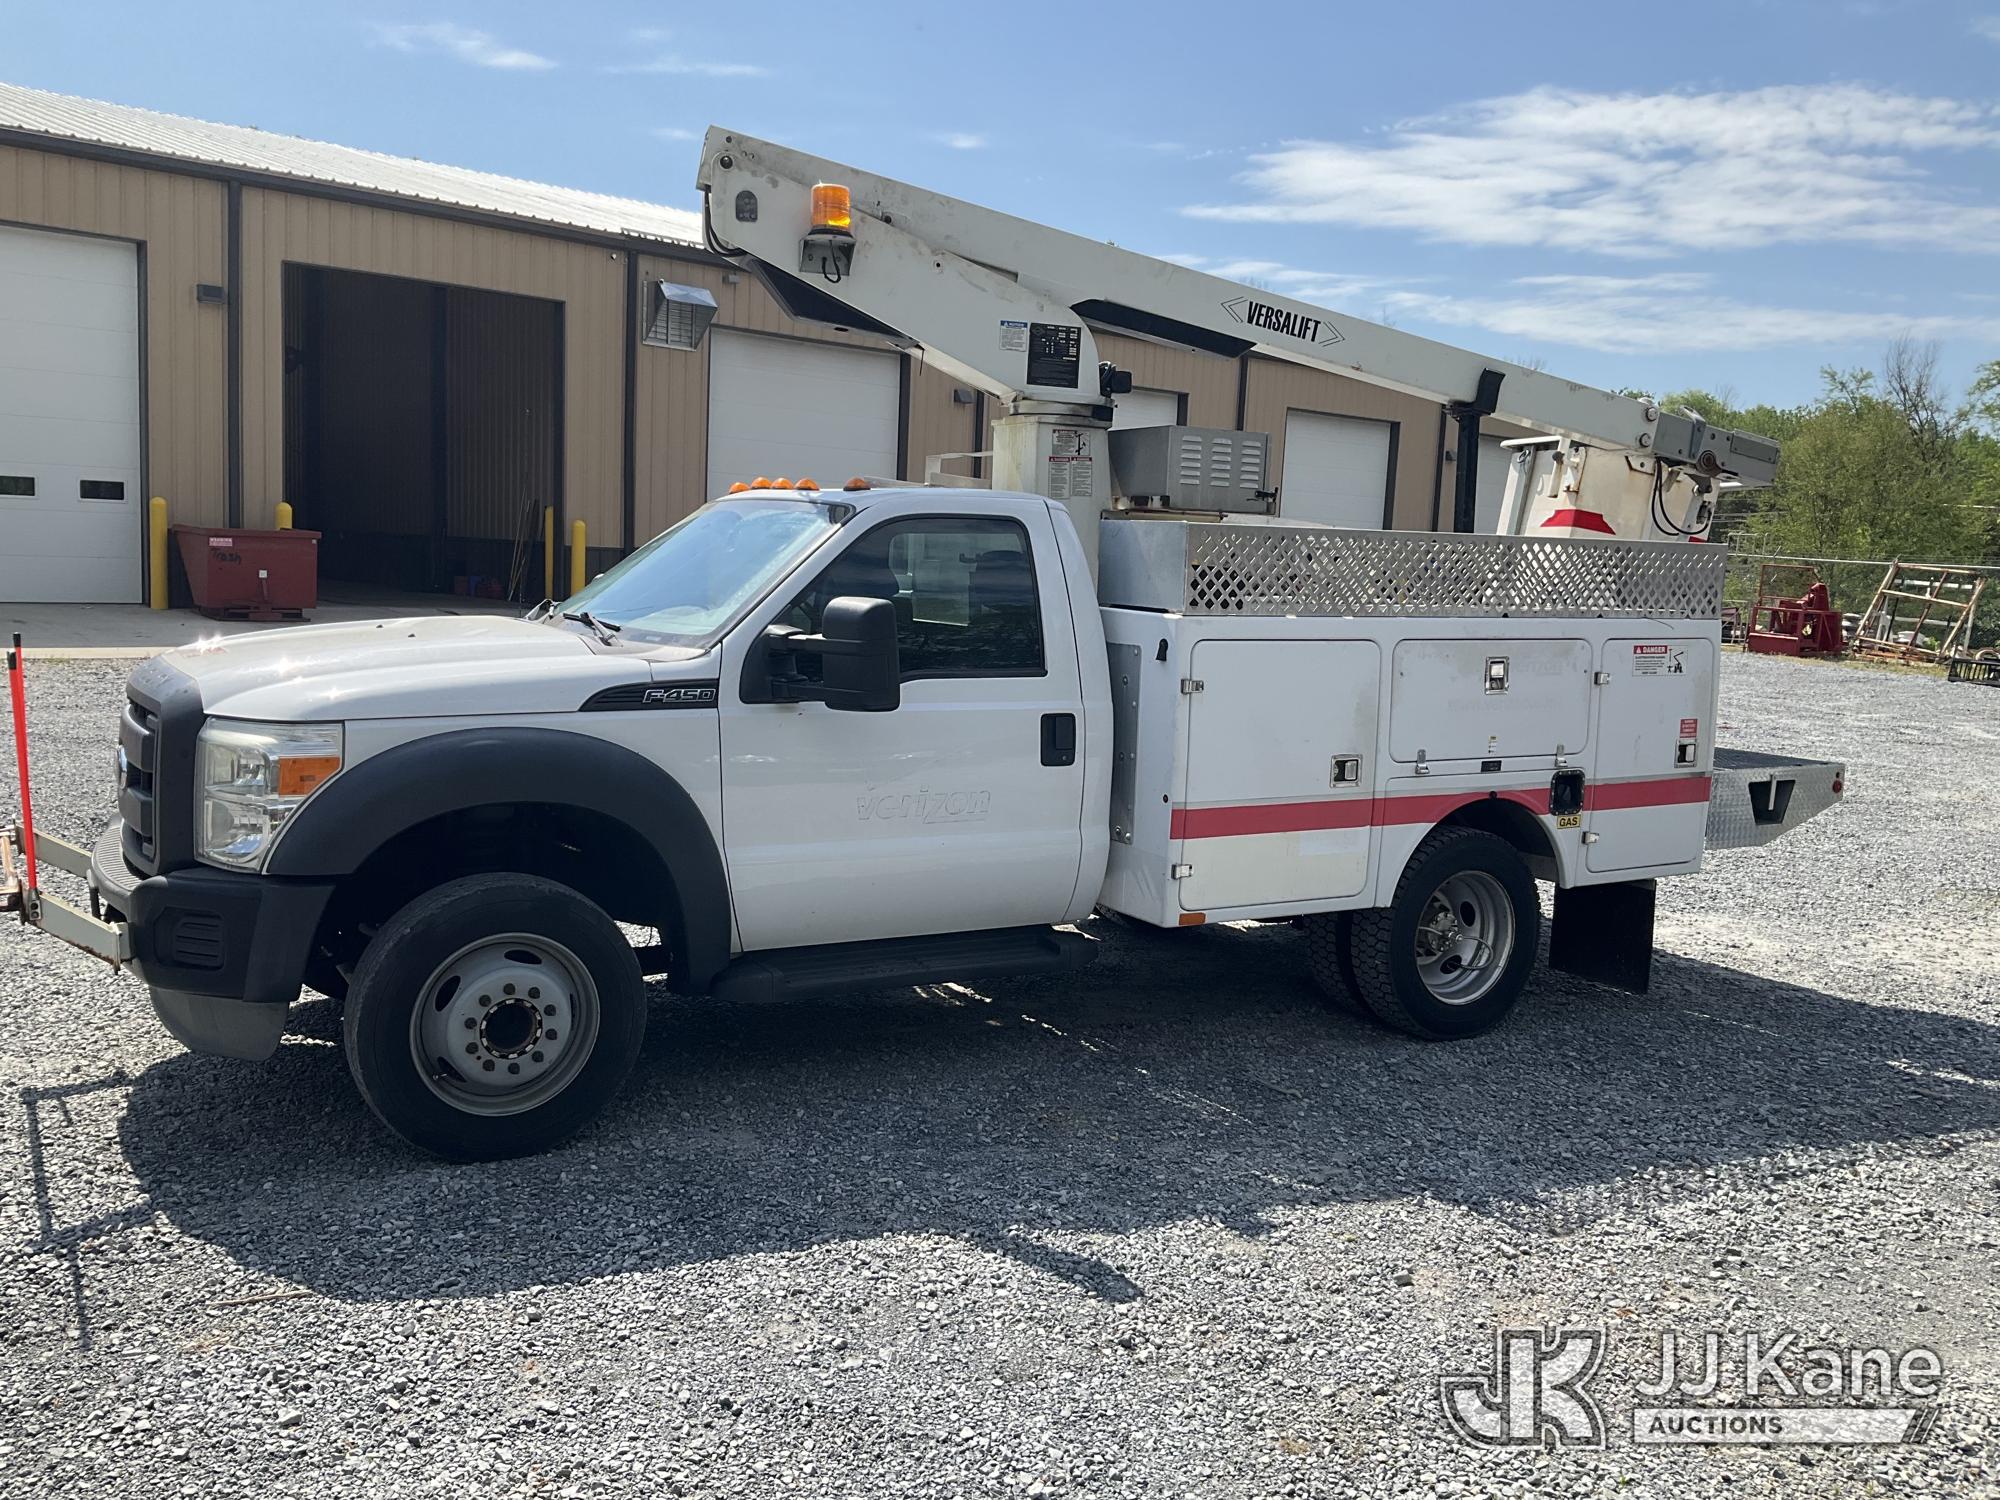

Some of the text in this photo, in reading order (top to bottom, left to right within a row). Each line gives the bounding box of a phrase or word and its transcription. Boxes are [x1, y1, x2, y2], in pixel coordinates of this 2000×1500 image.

[1247, 301, 1321, 342] VERSALIFT
[210, 547, 241, 565] Trash
[642, 688, 716, 703] F-450
[856, 785, 992, 824] verizon
[1559, 817, 1578, 827] GAS
